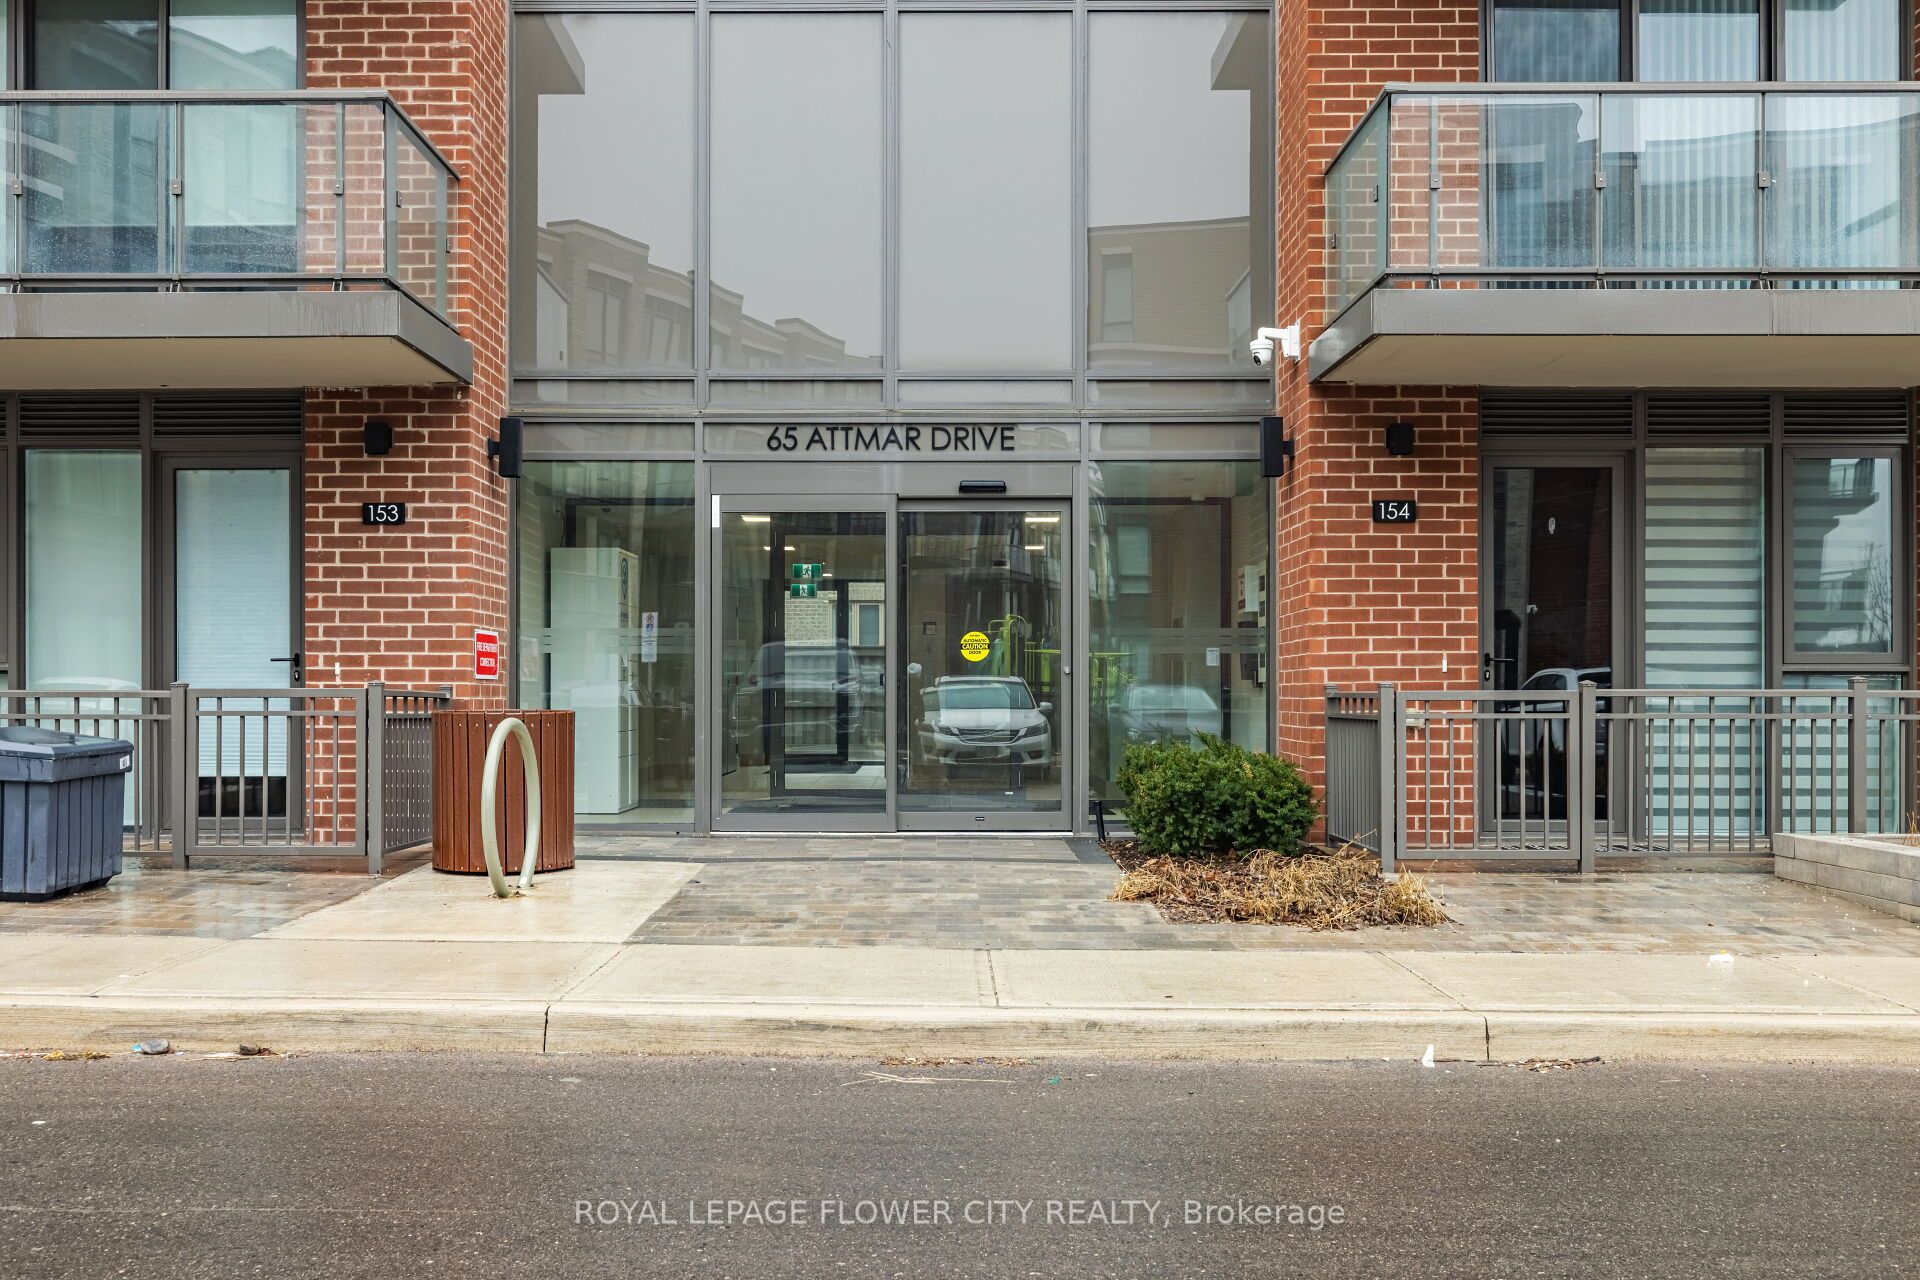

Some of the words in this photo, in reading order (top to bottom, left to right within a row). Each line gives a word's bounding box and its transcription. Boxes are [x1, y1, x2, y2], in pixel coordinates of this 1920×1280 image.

[767, 426, 798, 451] 65
[805, 426, 921, 451] ATTMAR
[931, 426, 1015, 451] DRIVE
[368, 504, 399, 522] 153
[1379, 502, 1410, 520] 154
